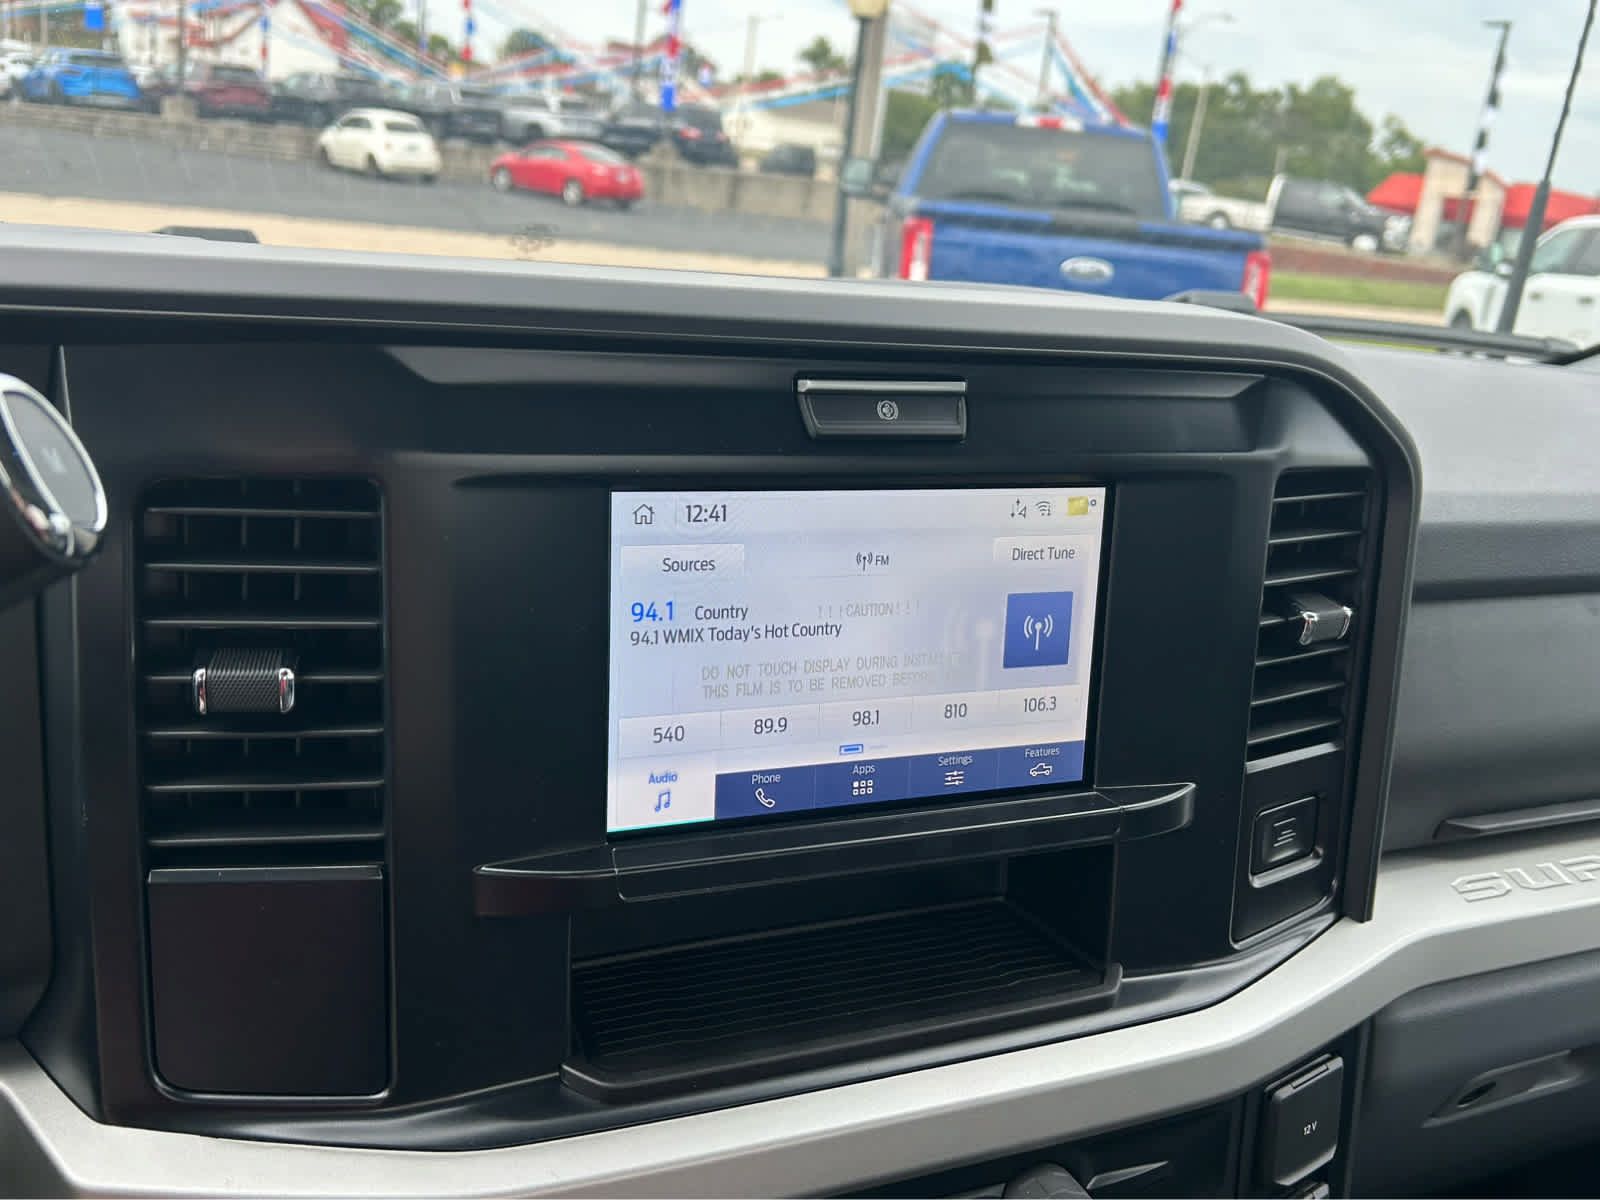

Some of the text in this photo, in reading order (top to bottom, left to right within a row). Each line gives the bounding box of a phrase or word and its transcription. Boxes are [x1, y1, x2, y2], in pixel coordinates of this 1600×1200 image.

[685, 504, 728, 523] 12:41
[874, 555, 890, 566] FM
[1012, 546, 1076, 561] Direct Tune
[662, 557, 716, 573] Sources
[631, 600, 749, 623] 94.1 Country
[845, 602, 894, 617] CAUTION
[630, 622, 842, 646] 94.1 WMIX Today's Hot Country
[726, 663, 751, 680] NOT
[758, 661, 799, 678] TOUCH
[803, 657, 851, 674] DISPLAY
[703, 683, 730, 700] THIS
[735, 680, 764, 697] FILM
[808, 676, 826, 692] BE
[944, 703, 968, 719] 810
[1023, 696, 1057, 713] 106.3
[852, 709, 881, 727] 98.1
[652, 725, 686, 744] 540
[753, 717, 788, 736] 89.9
[938, 754, 973, 767] Settings
[1024, 747, 1060, 758] Features
[648, 770, 679, 786] Audio
[852, 764, 876, 776] Apps
[751, 773, 782, 786] Phone
